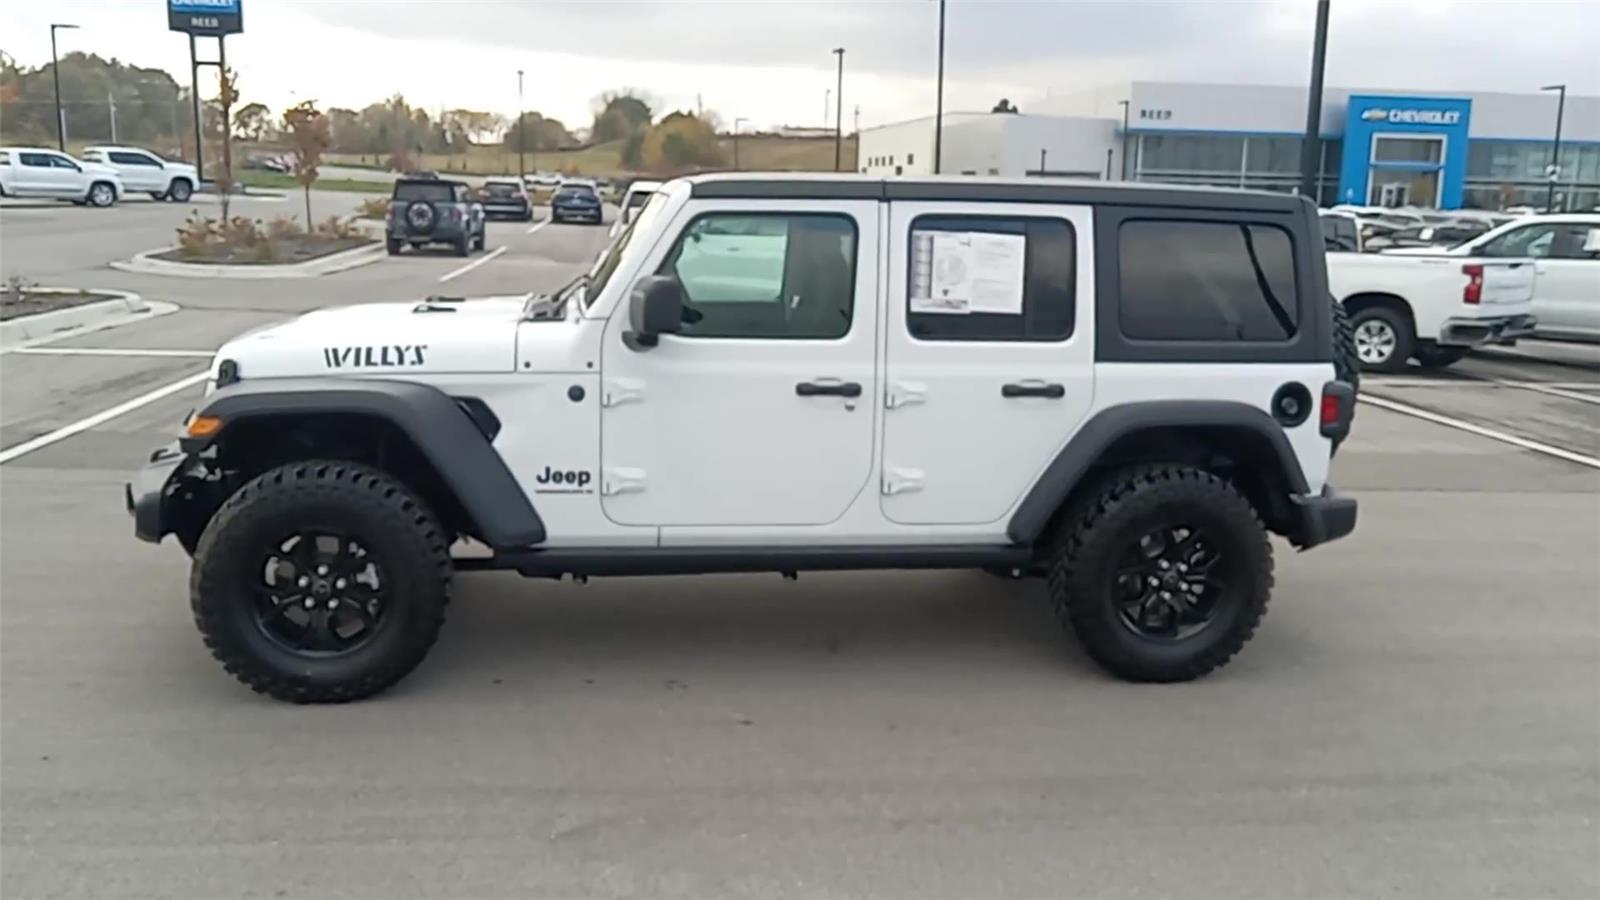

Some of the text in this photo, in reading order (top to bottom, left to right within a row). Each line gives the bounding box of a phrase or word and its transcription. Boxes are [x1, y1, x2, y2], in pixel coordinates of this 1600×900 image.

[1140, 109, 1172, 120] REED
[1389, 109, 1460, 124] CHEVROLET
[323, 344, 428, 368] WILLYS
[536, 465, 591, 488] Jeep
